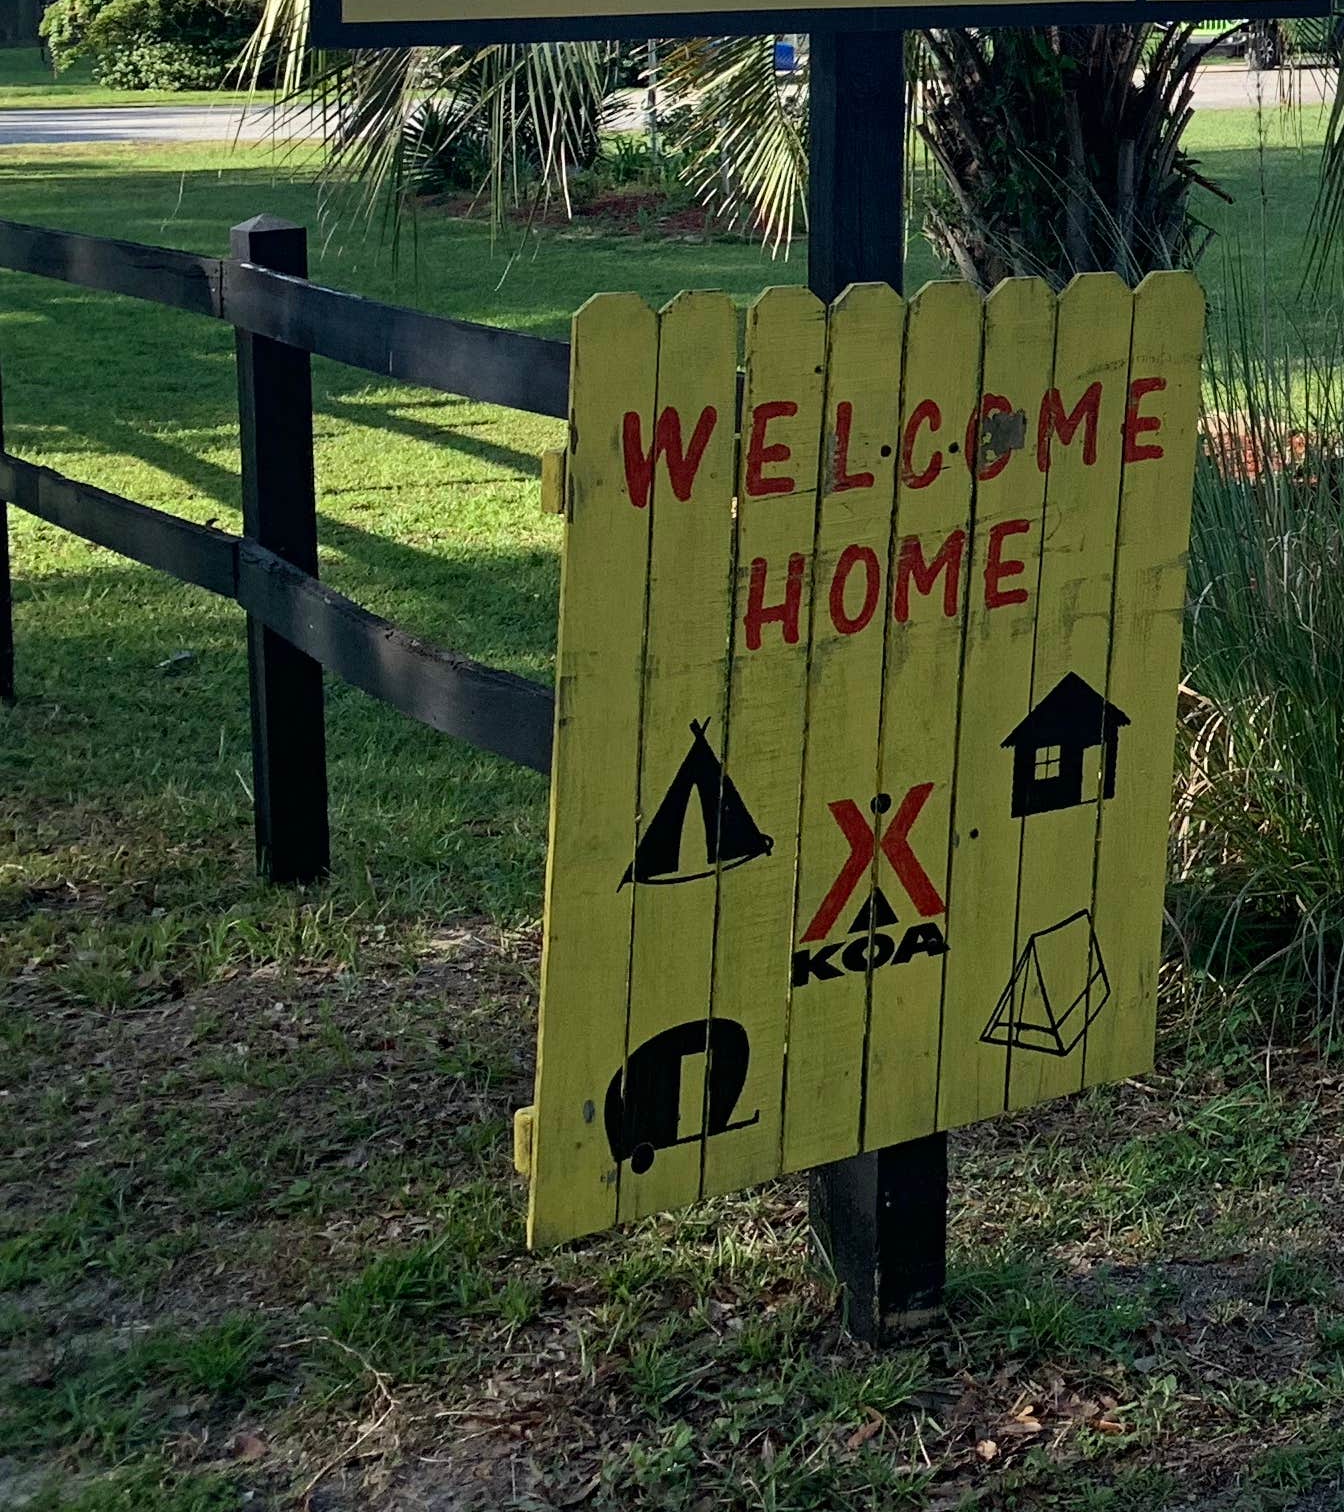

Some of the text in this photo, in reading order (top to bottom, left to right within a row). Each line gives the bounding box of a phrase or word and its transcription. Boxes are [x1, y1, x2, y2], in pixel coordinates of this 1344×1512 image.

[620, 377, 1168, 508] WELCOME
[744, 519, 1031, 650] HOME
[792, 921, 951, 988] KOA
